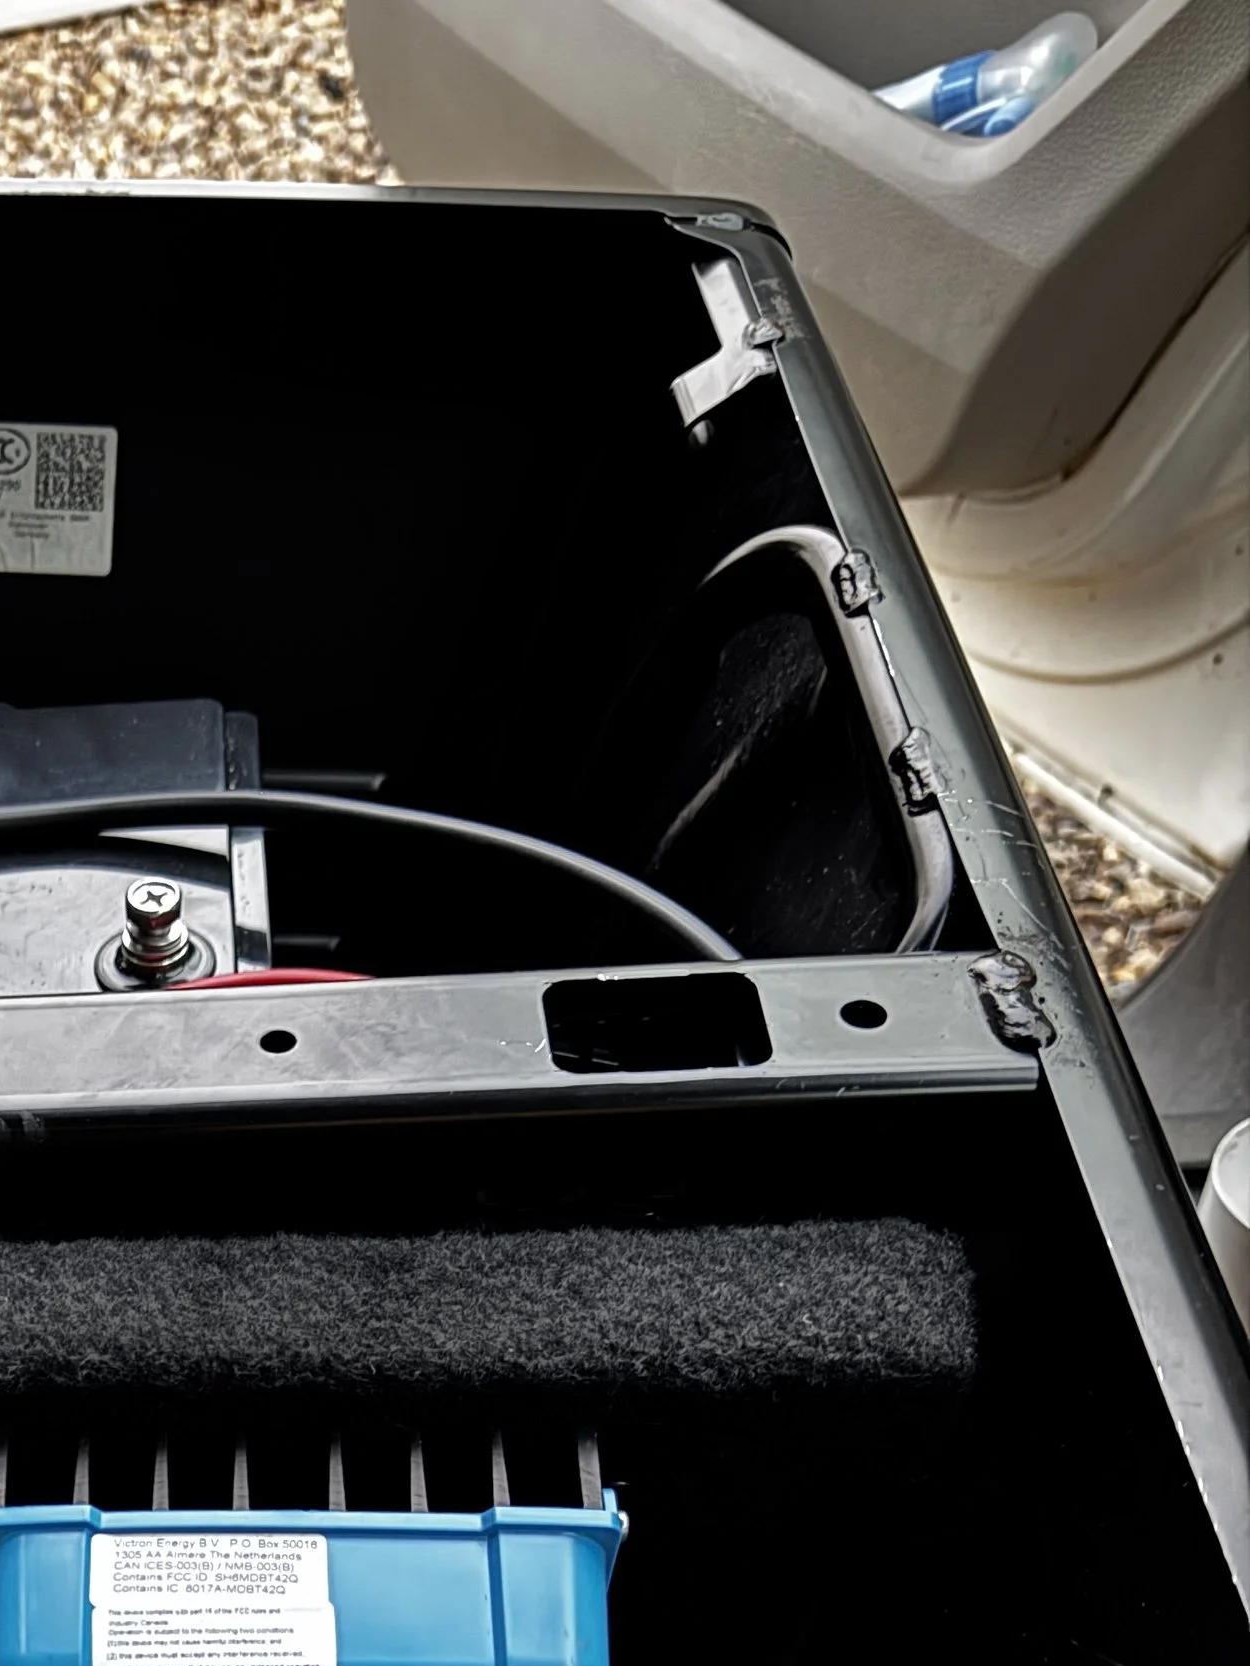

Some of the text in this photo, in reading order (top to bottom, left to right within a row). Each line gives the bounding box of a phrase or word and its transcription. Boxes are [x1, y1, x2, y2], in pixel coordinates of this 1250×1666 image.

[114, 1539, 152, 1548] Victron
[156, 1538, 195, 1549] Energy
[259, 1539, 279, 1548] Box
[116, 1551, 142, 1559] 1305
[210, 1551, 230, 1559] The
[235, 1552, 302, 1560] Netherlands
[114, 1561, 140, 1570] CAN
[144, 1561, 213, 1571] ICES-003(B)
[113, 1572, 163, 1581] Contains
[166, 1572, 191, 1581] FCC
[196, 1572, 208, 1581] ID
[113, 1583, 163, 1593] Contains
[166, 1584, 179, 1593] IC
